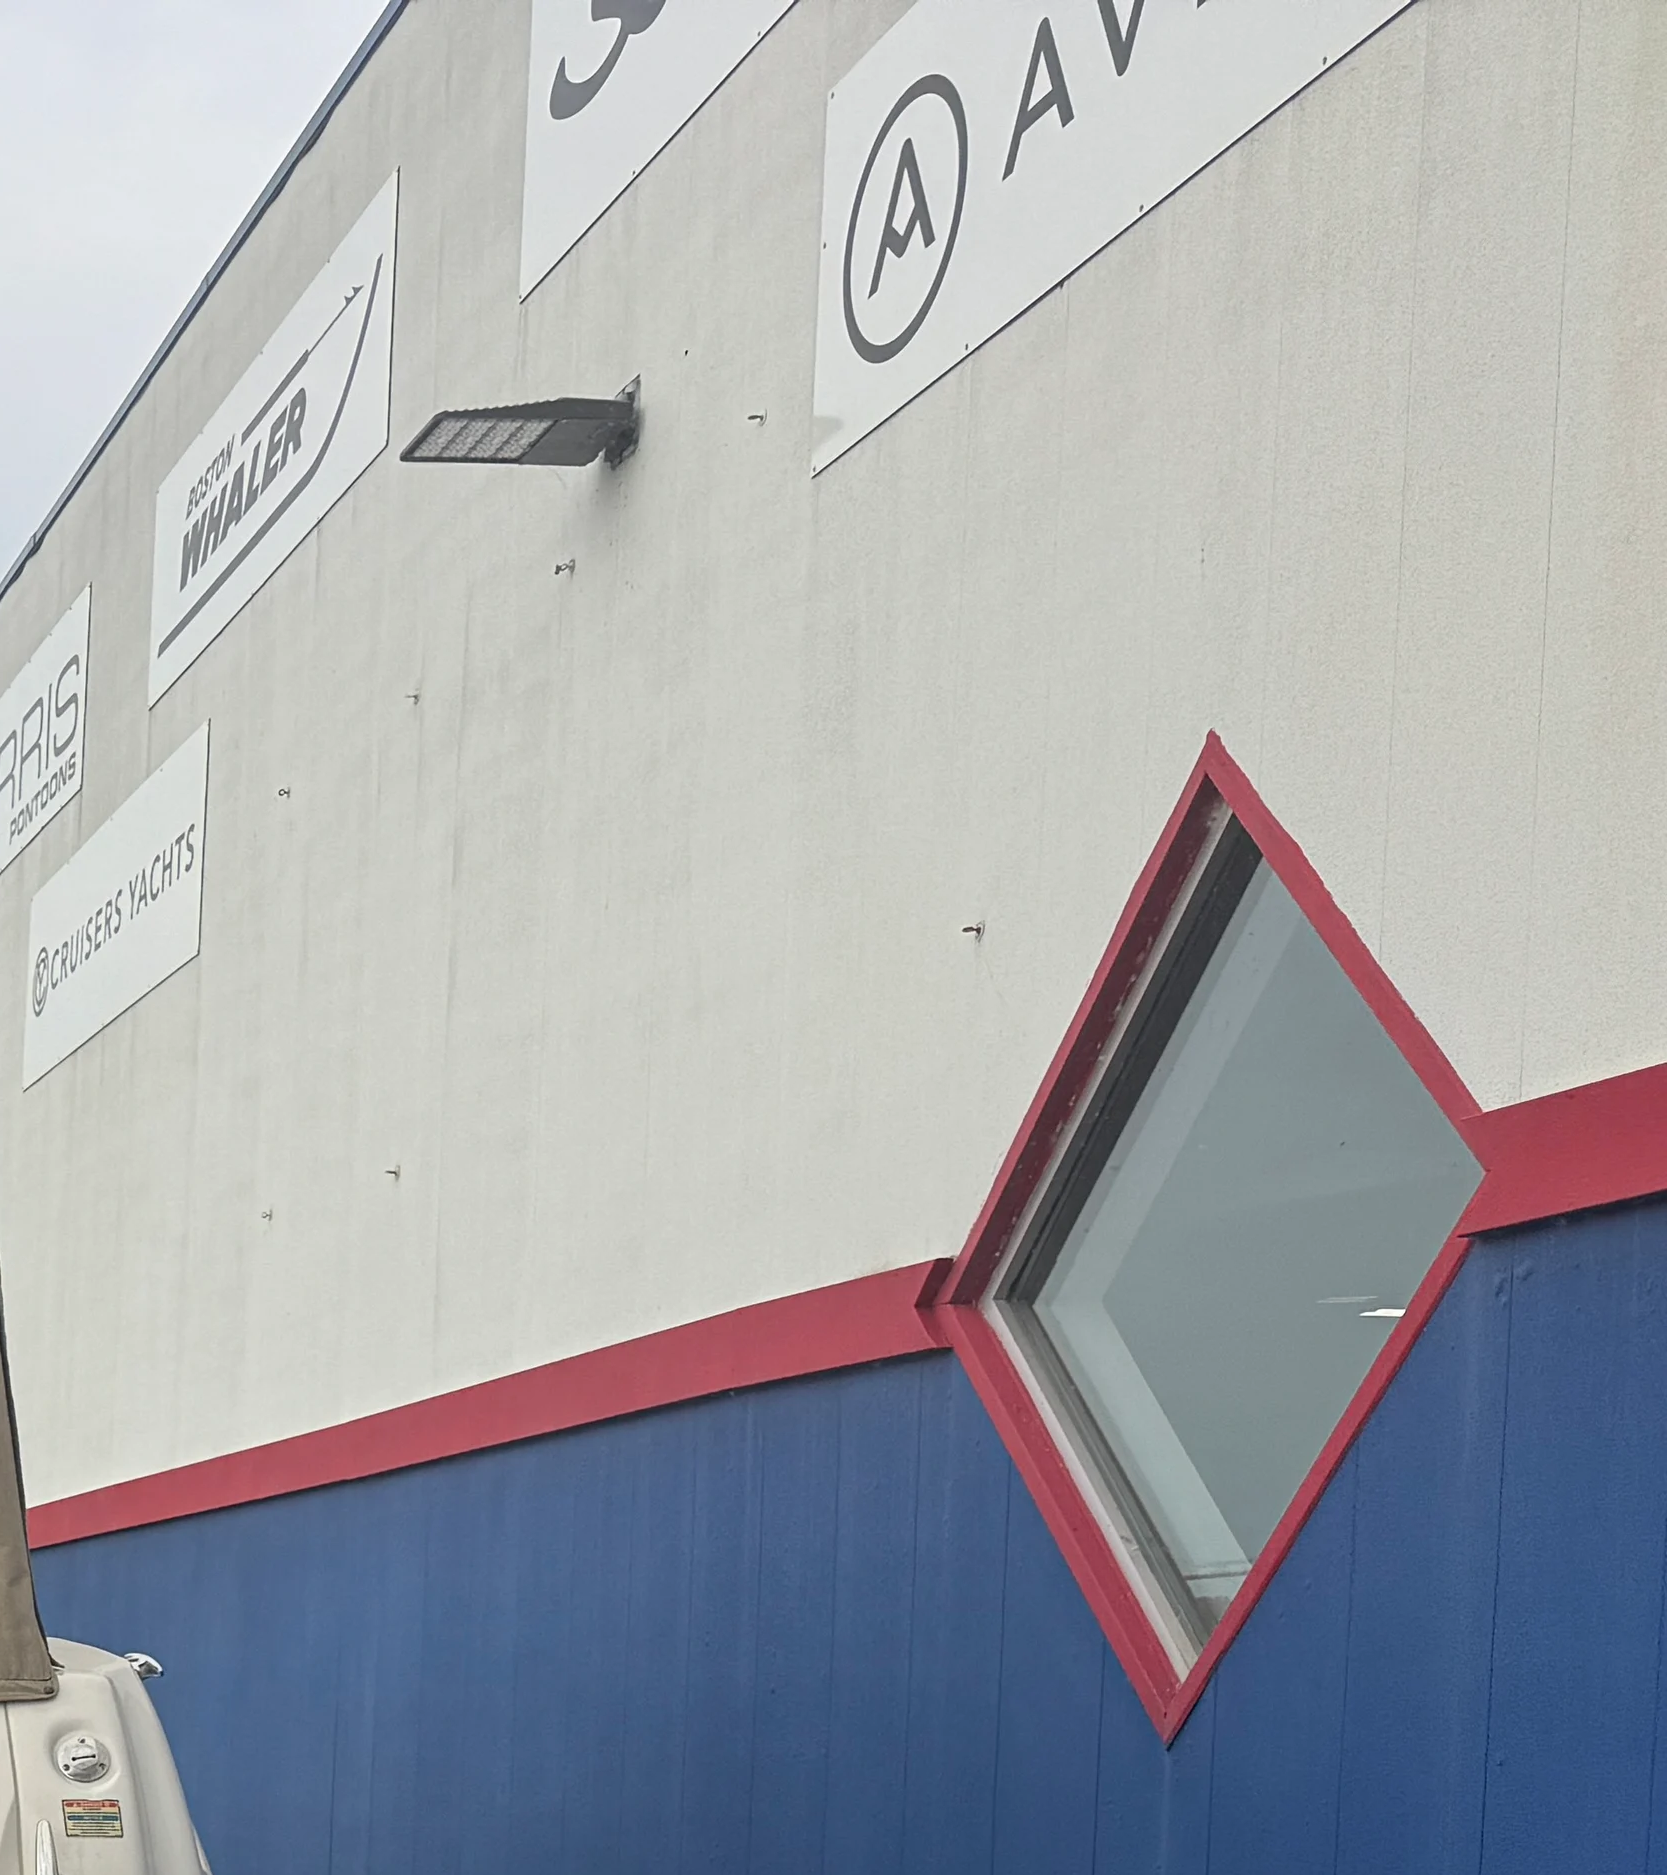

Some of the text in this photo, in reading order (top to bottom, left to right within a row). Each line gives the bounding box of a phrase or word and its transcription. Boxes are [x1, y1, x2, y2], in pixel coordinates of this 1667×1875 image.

[1001, 0, 1208, 182] AV
[179, 386, 307, 593] WHALER
[185, 432, 236, 521] BOSTON
[8, 750, 77, 846] PONTOONS
[49, 823, 196, 991] CRUISERS YACHTS
